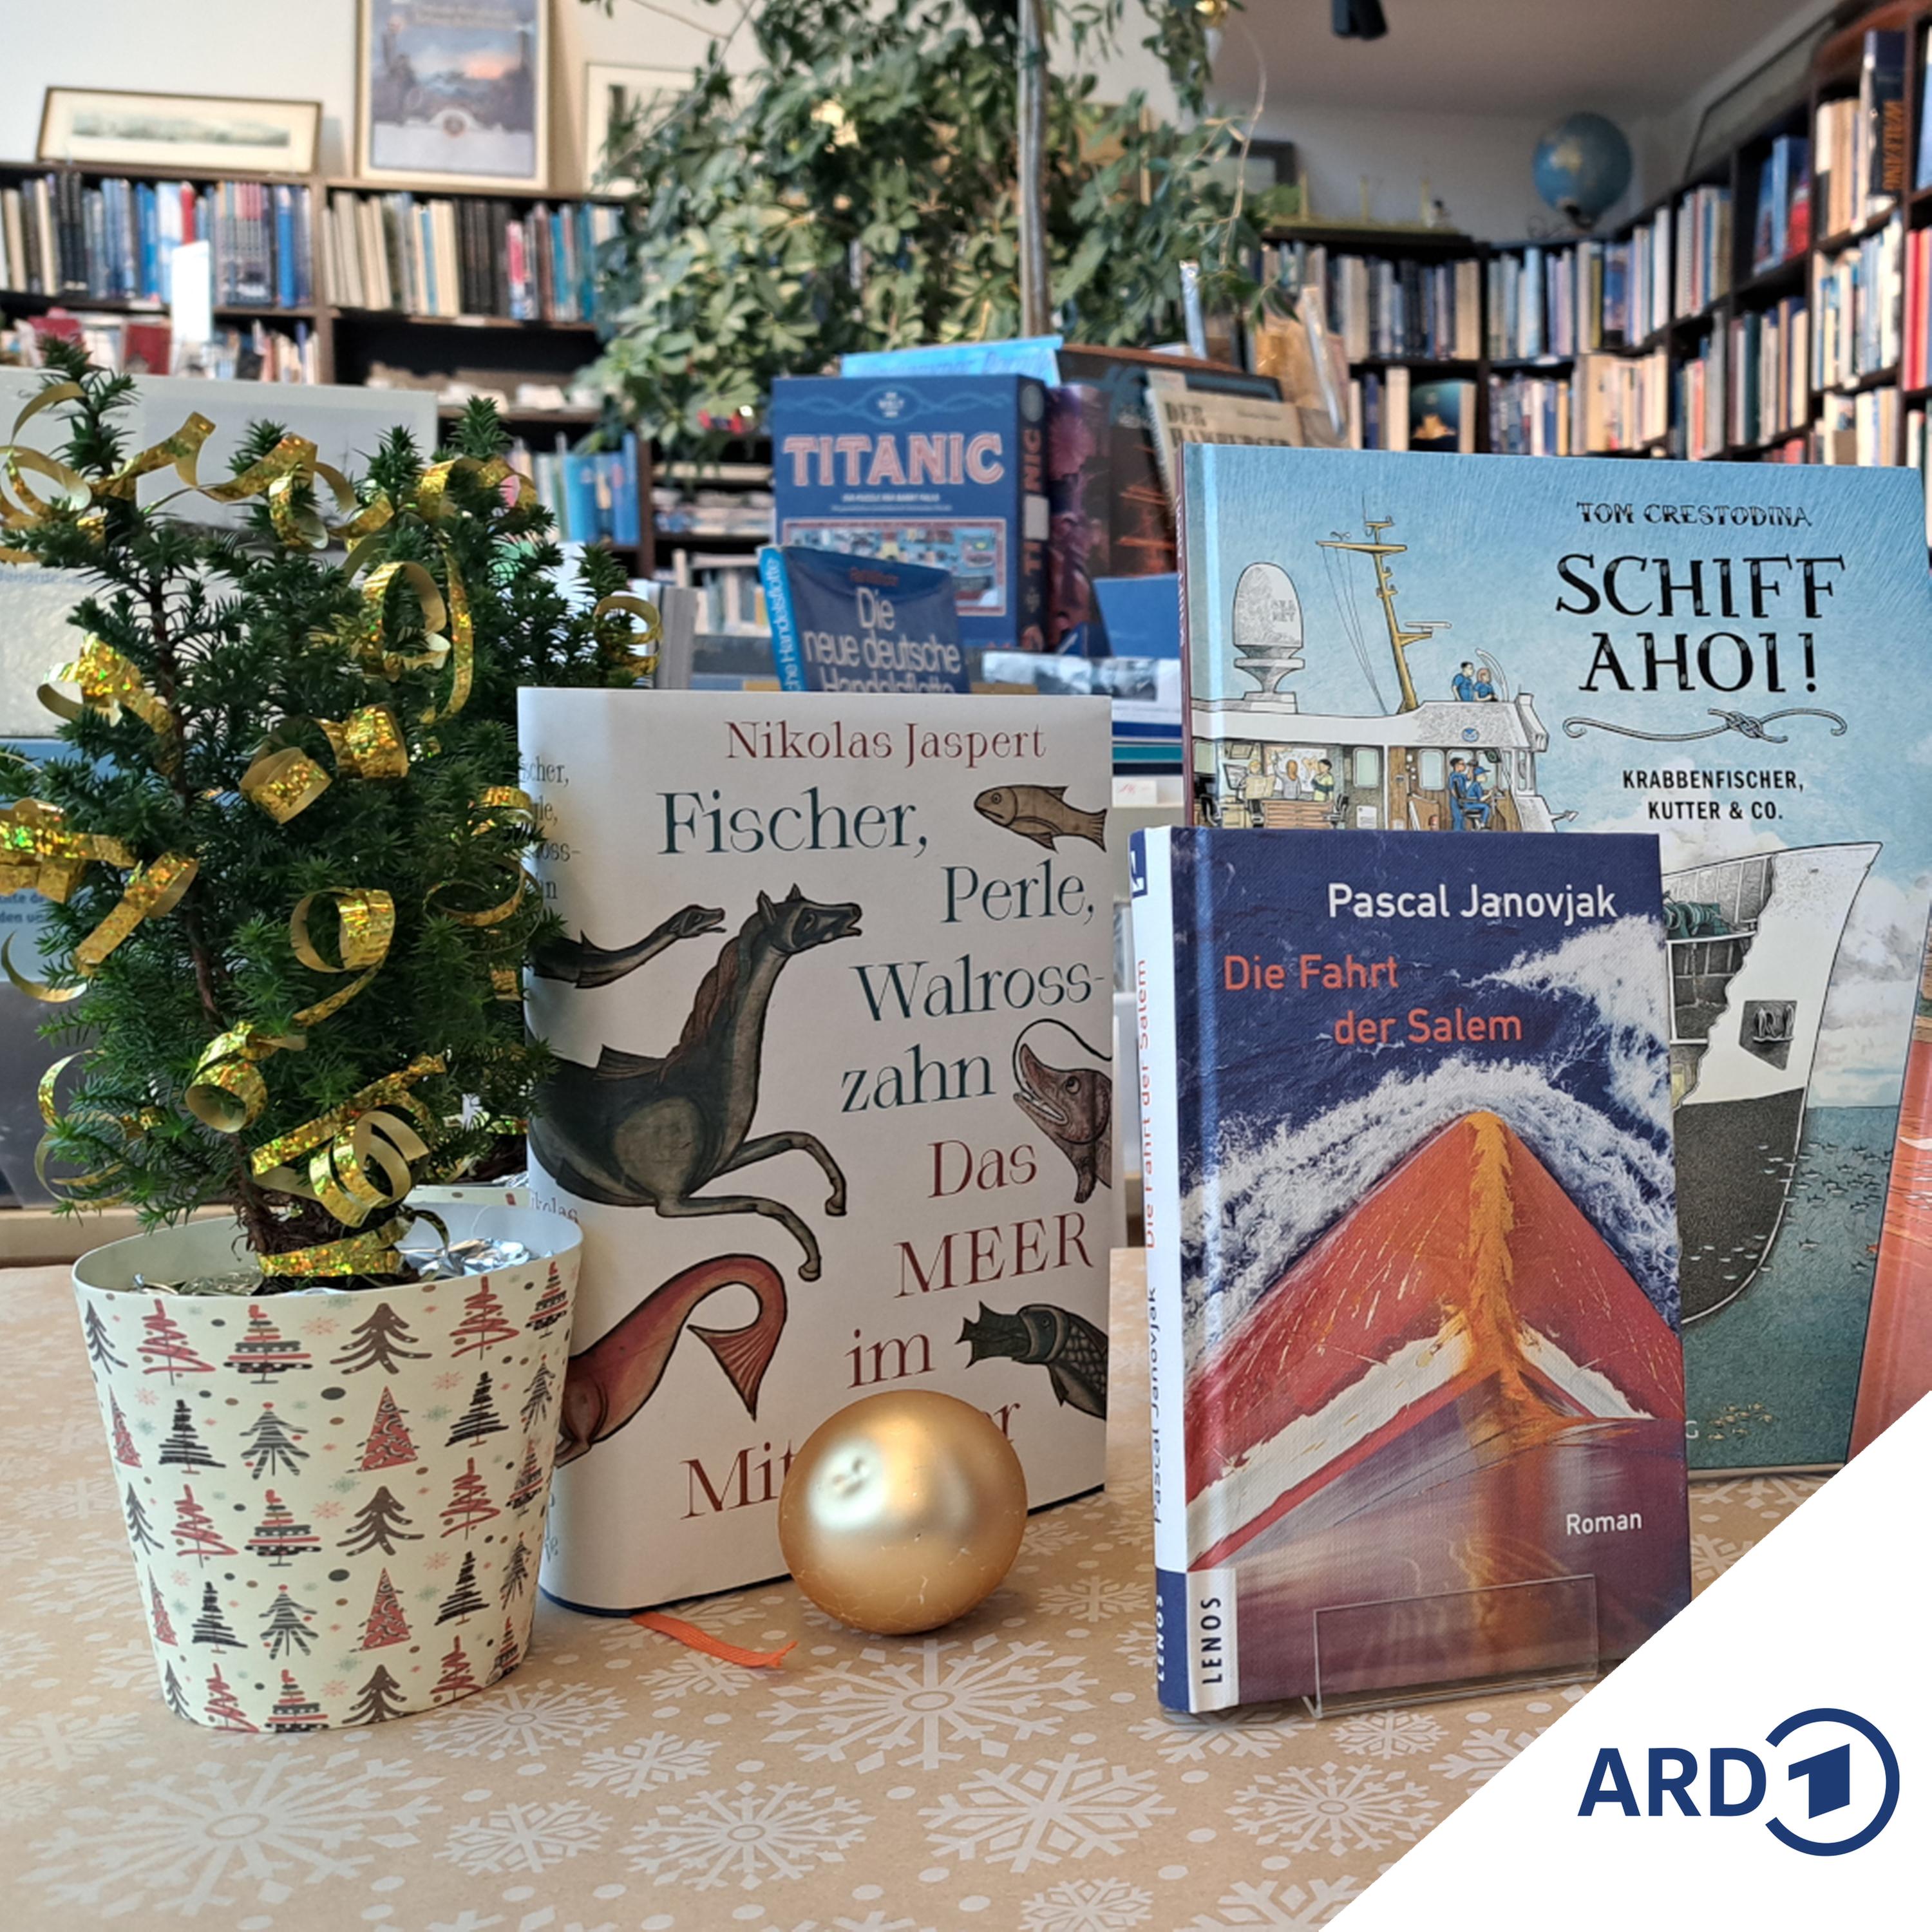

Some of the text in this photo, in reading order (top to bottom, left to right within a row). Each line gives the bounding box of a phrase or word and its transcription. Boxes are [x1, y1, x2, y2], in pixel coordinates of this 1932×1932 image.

[782, 433, 1004, 487] TITANIC
[1023, 430, 1041, 575] TINIC
[1577, 502, 1812, 527] TOM CRESTODINA
[856, 587, 896, 631] Die
[1556, 554, 1846, 618] SCHIFF
[804, 629, 961, 674] neue deutsche
[1578, 632, 1817, 693] AHOI!
[725, 719, 1046, 768] Nikolas Jaspert
[1622, 770, 1804, 792] KRABBENFISCHER,
[656, 786, 927, 858] Fischer,
[1648, 800, 1783, 819] KUTTER & CO.
[940, 858, 1095, 926] Perle,
[1328, 883, 1617, 926] Pascal Janovjak
[849, 954, 1105, 1022] Walross-
[1224, 952, 1399, 990] Die Fahrt
[1334, 1007, 1522, 1044] der Salem
[842, 1044, 996, 1113] zahn
[927, 1139, 1037, 1198] Das
[893, 1211, 1094, 1299] MEER
[844, 1328, 936, 1389] im
[1566, 1512, 1642, 1535] Roman
[1200, 1597, 1222, 1685] LENOS
